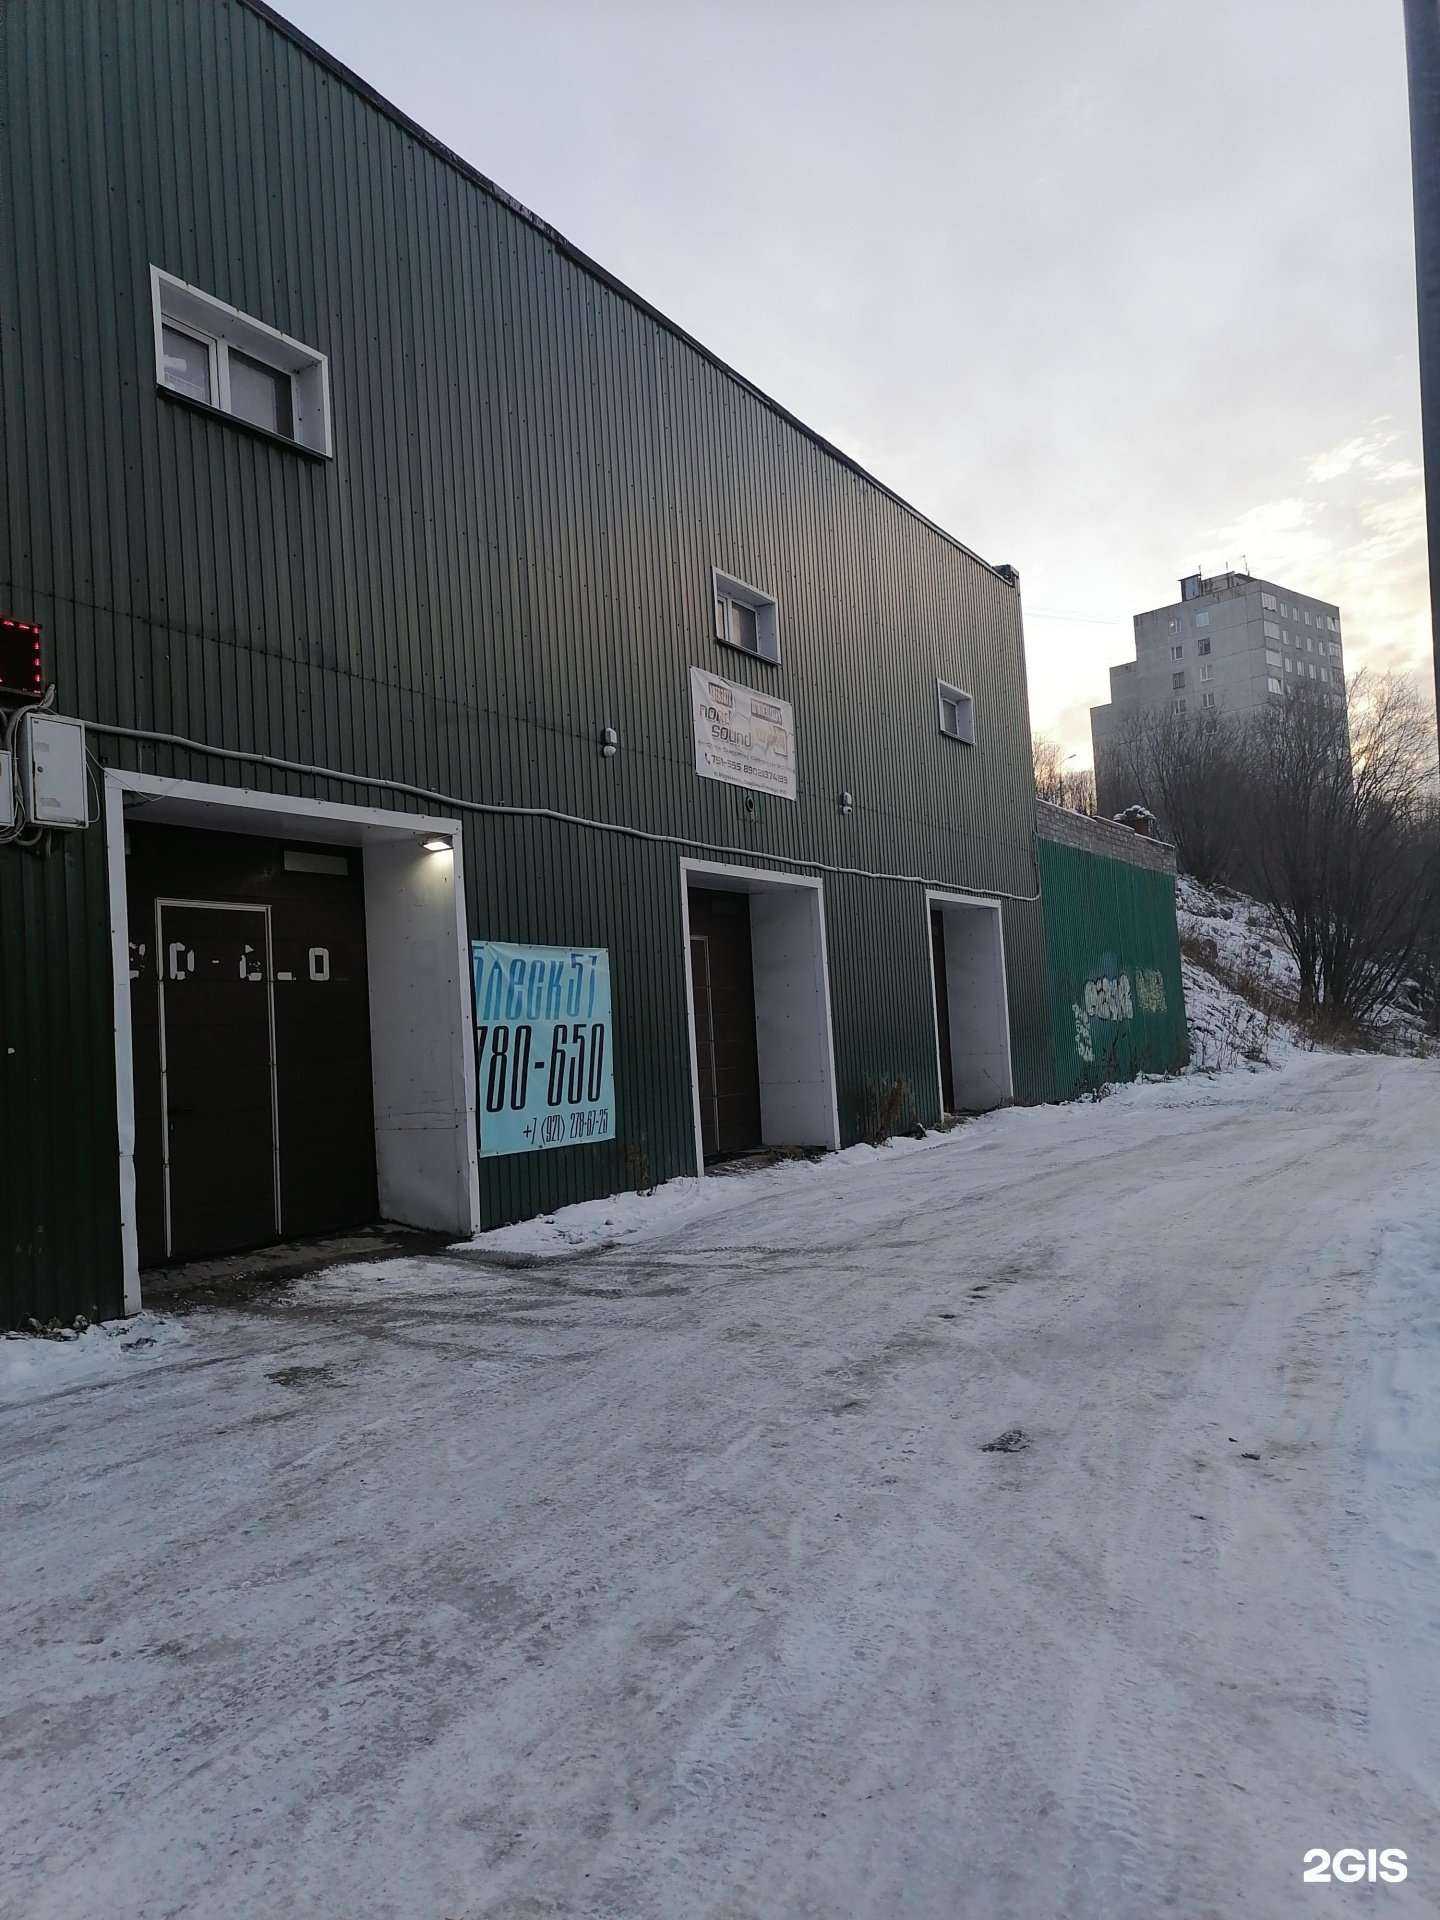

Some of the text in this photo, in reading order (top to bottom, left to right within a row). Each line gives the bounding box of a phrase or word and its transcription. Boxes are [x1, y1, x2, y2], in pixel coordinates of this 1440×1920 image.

[475, 1024, 605, 1112] 780-650
[523, 1117, 537, 1144] +7
[541, 1114, 566, 1145] (921)
